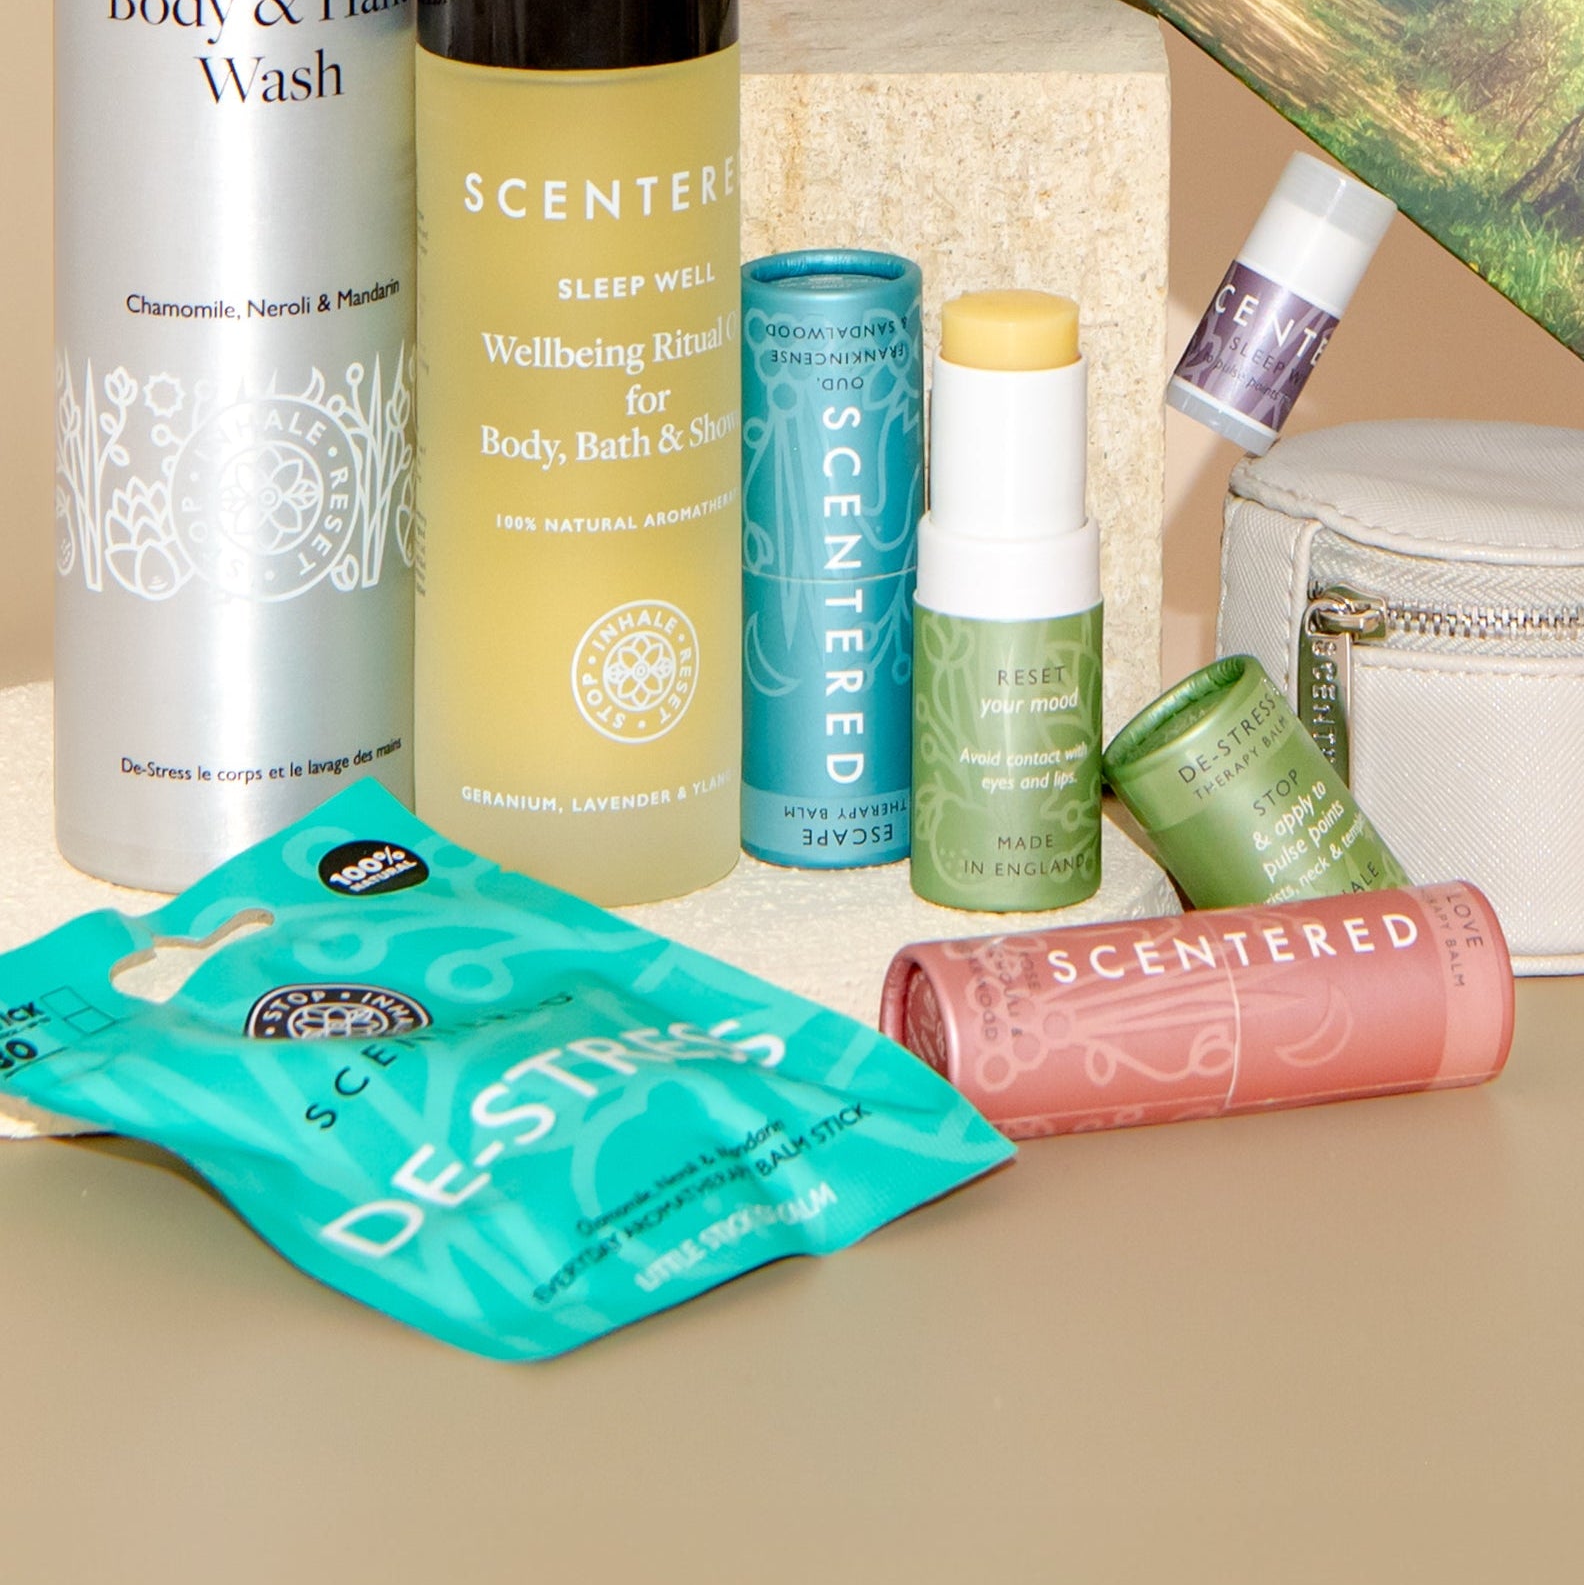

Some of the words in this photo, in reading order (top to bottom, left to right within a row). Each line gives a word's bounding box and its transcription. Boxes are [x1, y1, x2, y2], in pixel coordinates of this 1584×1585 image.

[193, 48, 345, 104] Wash
[126, 294, 242, 321] Chamomile,
[247, 296, 311, 319] Neroli
[316, 293, 332, 312] &
[337, 278, 401, 310] Mandarin
[558, 275, 646, 300] SLEEP
[653, 262, 716, 294] WELL
[480, 329, 646, 376] Wellbeing
[652, 318, 722, 363] Ritual
[765, 322, 896, 340] SANDALWOOD
[770, 343, 905, 366] FRANKINCENSE
[1228, 335, 1286, 374] SLEEP
[624, 383, 672, 417] for
[816, 375, 865, 392] OUD,
[480, 424, 567, 471] Body,
[574, 423, 652, 463] Bath
[657, 422, 685, 455] &
[495, 513, 538, 532] 100%
[544, 516, 638, 534] NATURAL
[822, 405, 865, 785] SCENTERED
[592, 608, 678, 653] INHALE
[657, 646, 692, 725] RESET
[996, 665, 1066, 687] RESET
[581, 672, 626, 730] STOP
[980, 697, 1025, 719] your
[1029, 686, 1080, 713] mood
[959, 747, 1001, 767] Avoid
[1006, 748, 1061, 767] contact
[1065, 740, 1089, 762] with
[1177, 691, 1277, 785] DE-STRESS
[1192, 748, 1259, 802] THERAPY
[1260, 716, 1291, 749] BALM
[120, 756, 192, 782] De-Stress
[196, 764, 212, 782] le
[216, 765, 263, 786] corps
[267, 764, 285, 779] et
[289, 760, 303, 778] le
[307, 755, 350, 776] lavage
[352, 748, 374, 767] des
[981, 776, 1015, 795] eyes
[1020, 773, 1049, 791] and
[1053, 770, 1078, 791] lips.
[461, 785, 564, 814] GERANIUM,
[571, 786, 672, 814] LAVENDER
[676, 785, 688, 801] &
[783, 805, 828, 820] BALM
[837, 799, 908, 819] THERAPY
[1251, 767, 1300, 818] STOP
[801, 823, 894, 846] ESCAPE
[1252, 831, 1273, 852] &
[1274, 793, 1314, 843] apply
[1311, 781, 1327, 802] to
[997, 833, 1055, 851] MADE
[1262, 837, 1309, 884] pulse
[1307, 800, 1345, 848] points
[329, 845, 407, 888] 100%
[348, 858, 420, 893] NATURAL
[963, 858, 985, 876] IN
[994, 851, 1086, 878] ENGLAND
[1298, 855, 1332, 890] neck
[1328, 843, 1343, 861] &
[1445, 893, 1485, 949] LOVE
[1046, 912, 1419, 986] SCENTERED
[1444, 937, 1466, 988] BALM
[262, 989, 327, 1023] STOP
[321, 1018, 787, 1259] DE-STRESS
[756, 1133, 808, 1177] BALM
[810, 1102, 873, 1145] STICK
[634, 1238, 707, 1293] LITTLE
